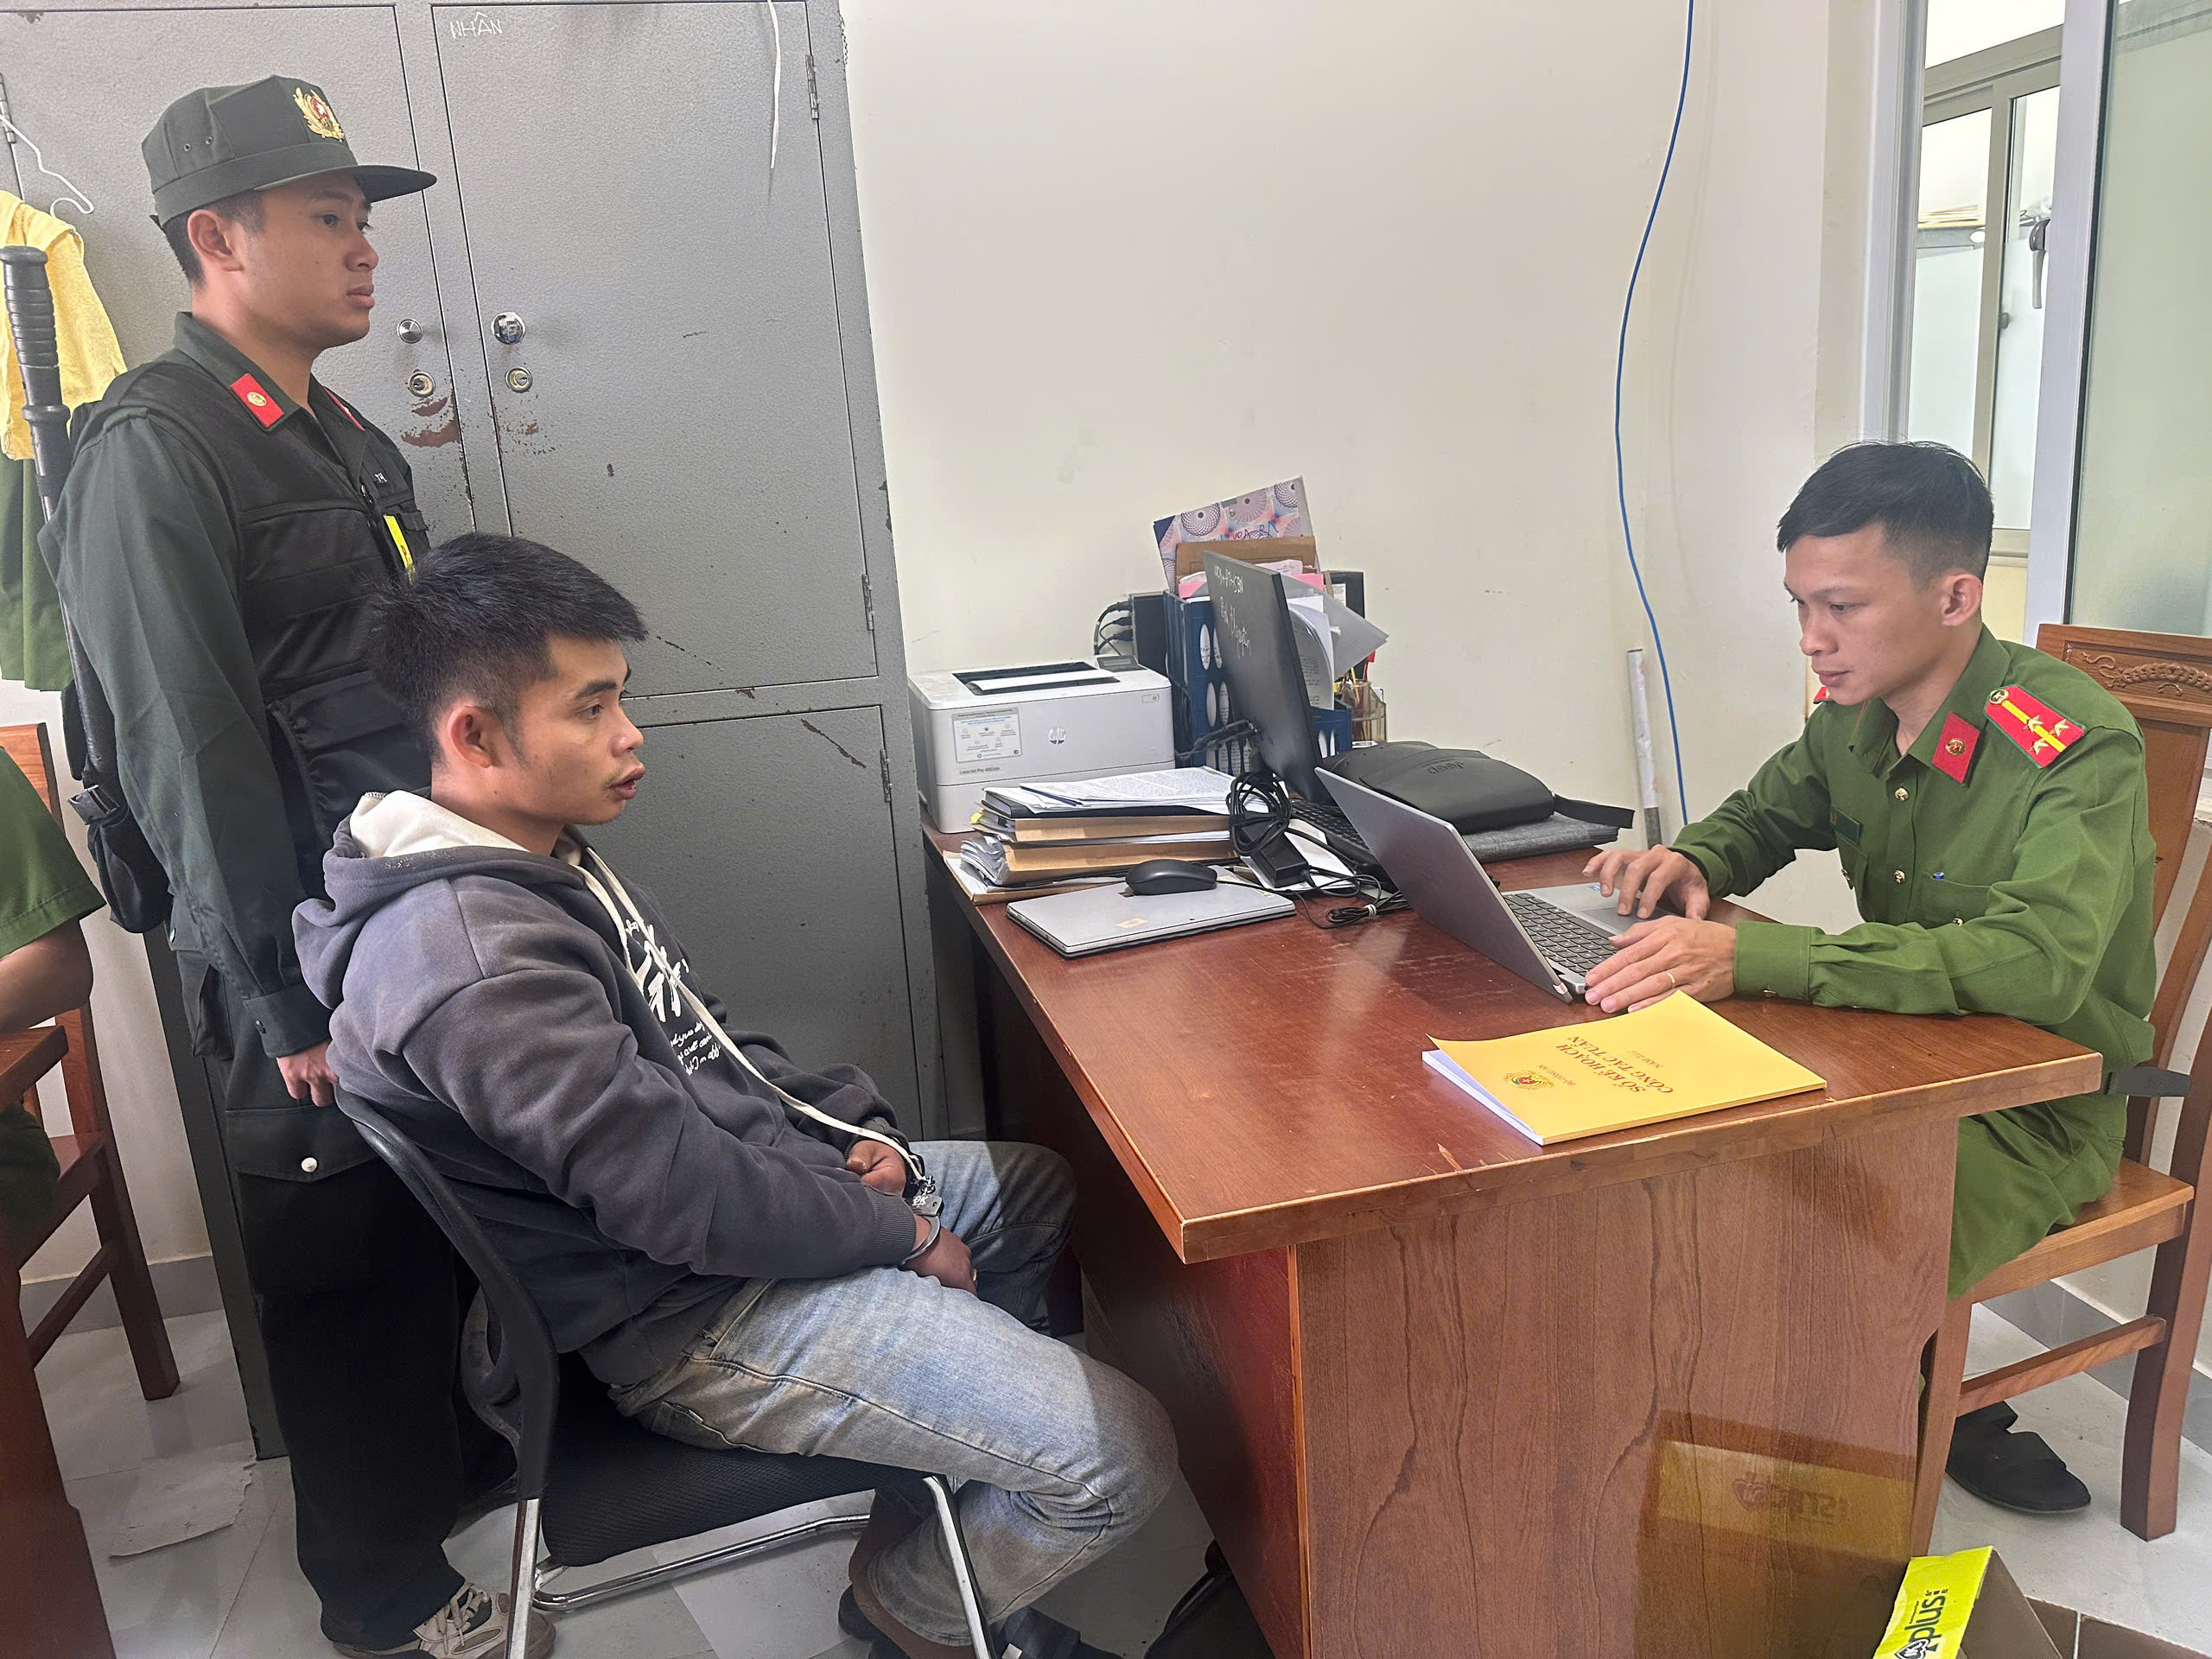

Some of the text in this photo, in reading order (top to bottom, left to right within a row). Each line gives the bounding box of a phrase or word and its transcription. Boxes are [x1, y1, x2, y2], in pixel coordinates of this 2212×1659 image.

[450, 11, 503, 39] NHÂN
[1555, 1044, 1605, 1071] HOẠCH
[1602, 1056, 1634, 1071] TÁC
[1630, 1071, 1674, 1094] CÔNG
[1904, 1595, 1946, 1643] plus
